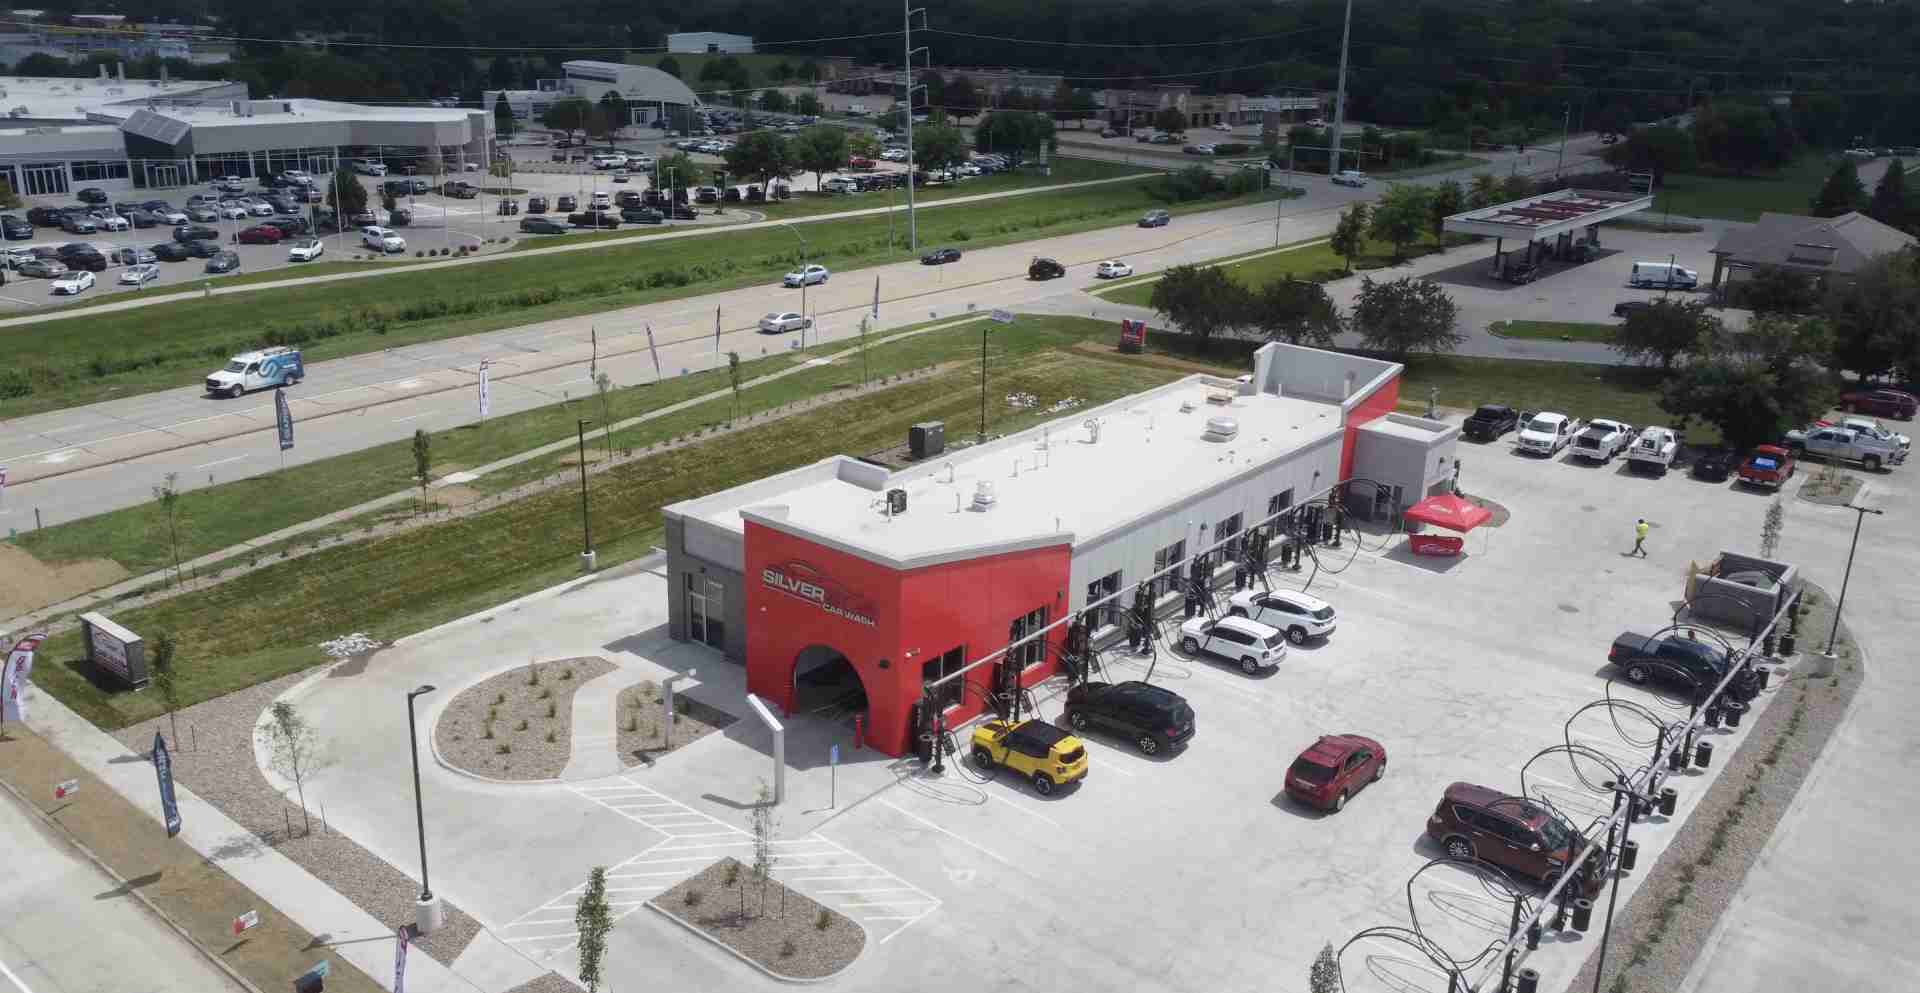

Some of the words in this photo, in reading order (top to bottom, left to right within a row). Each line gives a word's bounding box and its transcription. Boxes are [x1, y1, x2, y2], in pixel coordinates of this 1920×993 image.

[762, 569, 825, 602] SILVER
[822, 602, 844, 616] CAR
[845, 610, 875, 626] WASH
